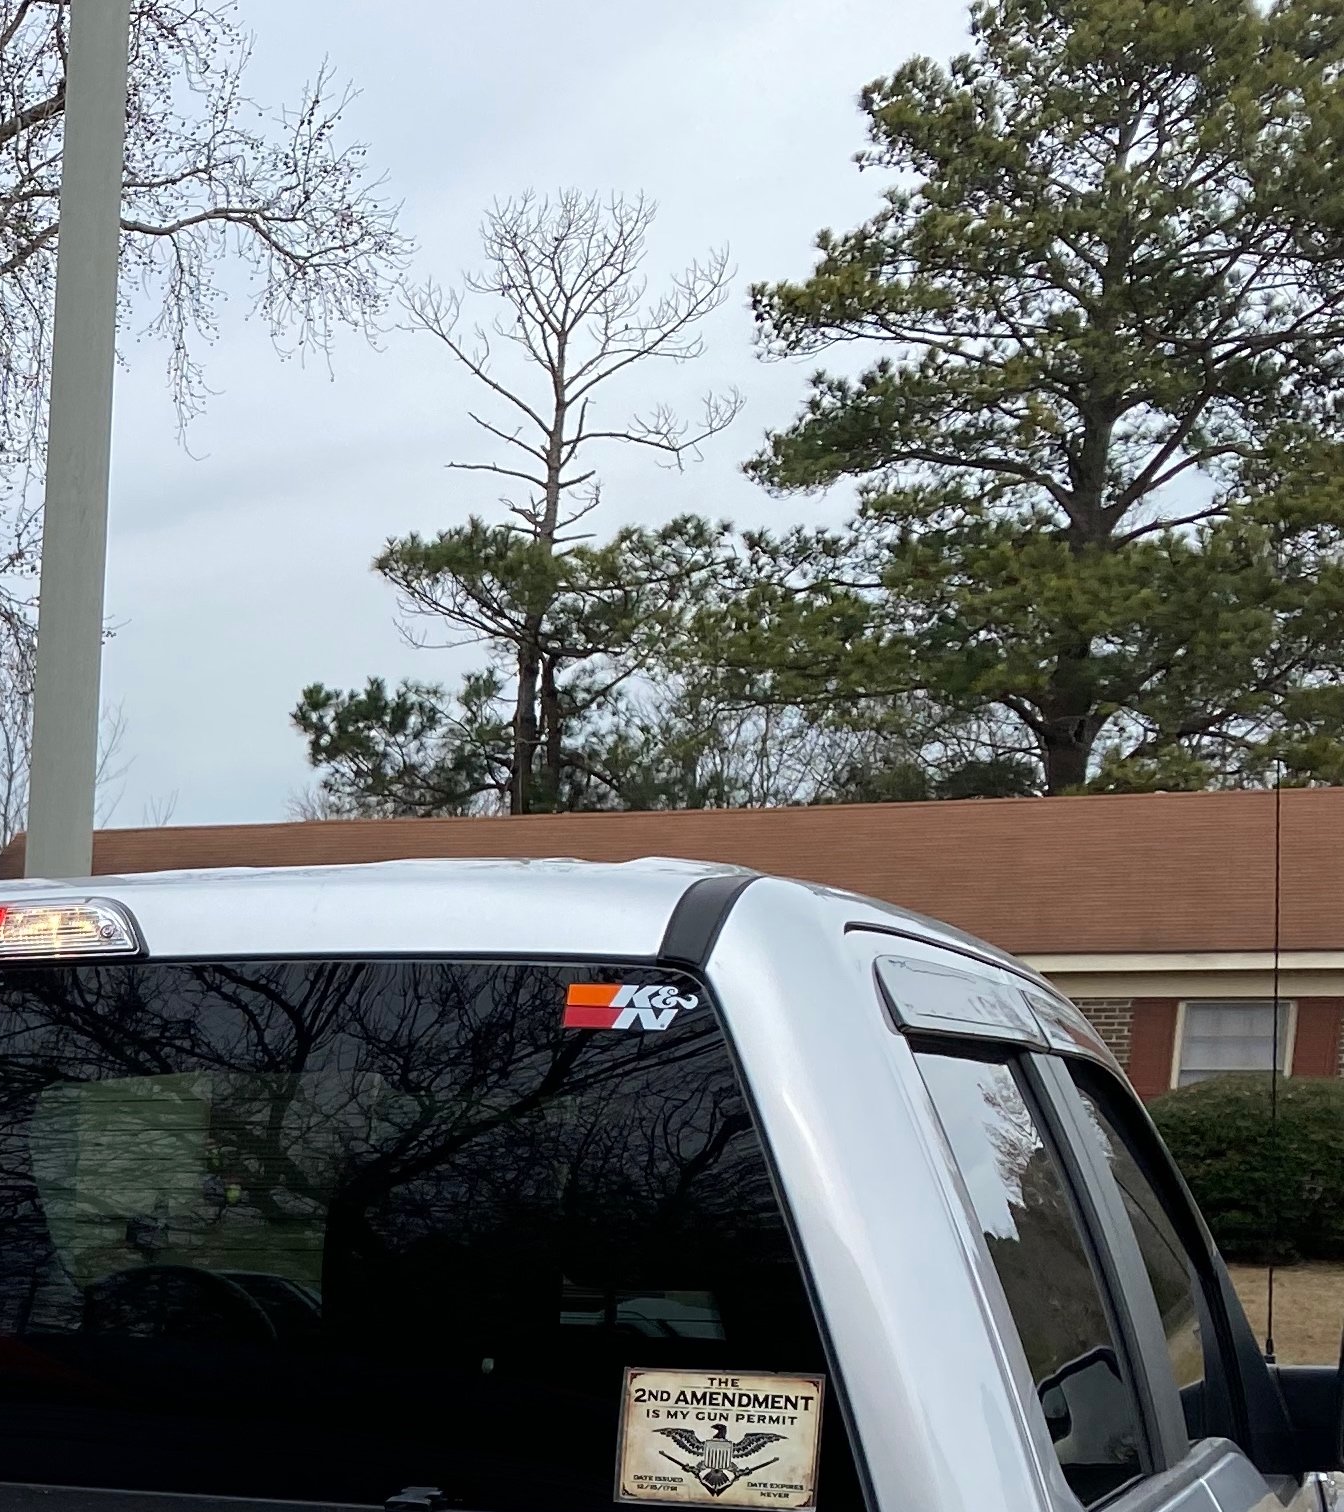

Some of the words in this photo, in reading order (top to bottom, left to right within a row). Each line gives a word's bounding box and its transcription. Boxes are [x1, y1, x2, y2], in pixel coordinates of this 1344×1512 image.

[707, 1377, 740, 1388] THE
[634, 1388, 671, 1403] 2ND
[674, 1390, 815, 1411] AMENDMENT
[646, 1409, 660, 1419] IS
[666, 1410, 690, 1420] MY
[695, 1411, 730, 1422] GUN
[735, 1414, 798, 1426] PERMIT
[633, 1474, 654, 1482] DATE
[747, 1481, 768, 1489] DATE
[769, 1483, 804, 1491] EXPIRES
